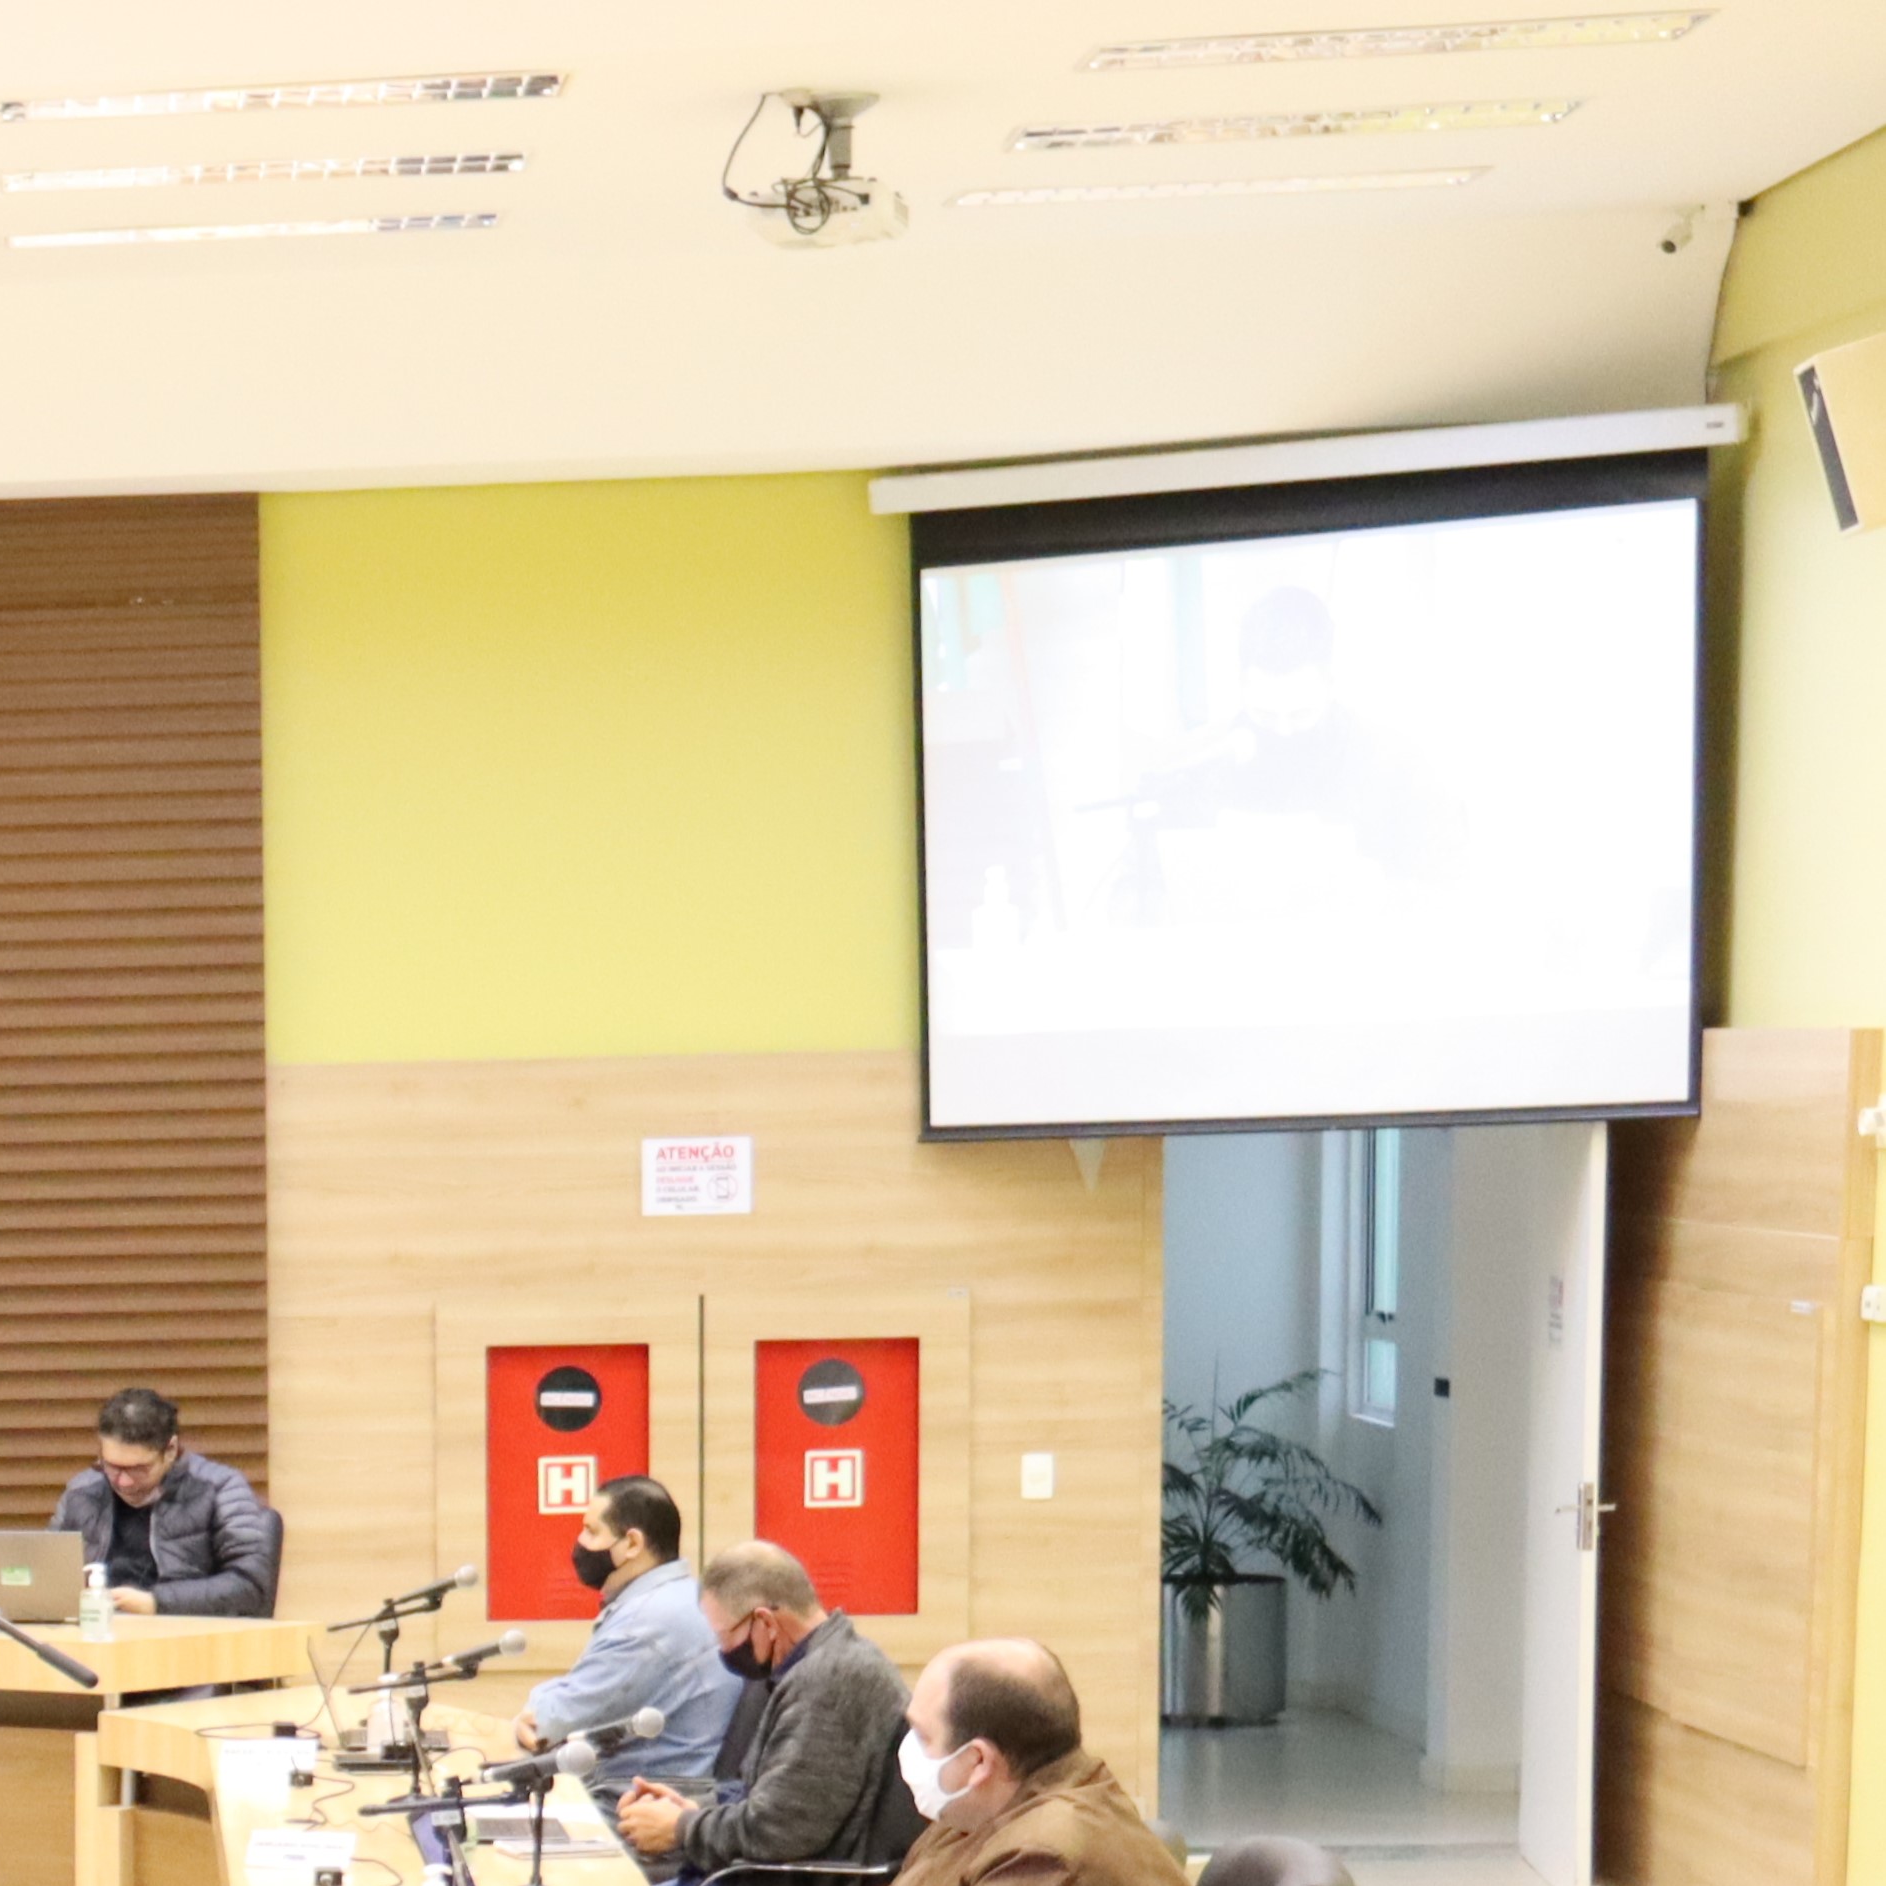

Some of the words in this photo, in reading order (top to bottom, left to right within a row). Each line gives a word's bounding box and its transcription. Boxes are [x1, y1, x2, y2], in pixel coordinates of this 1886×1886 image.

[656, 1142, 735, 1163] ATENÇÃO
[547, 1466, 587, 1505] H
[813, 1459, 854, 1498] H
